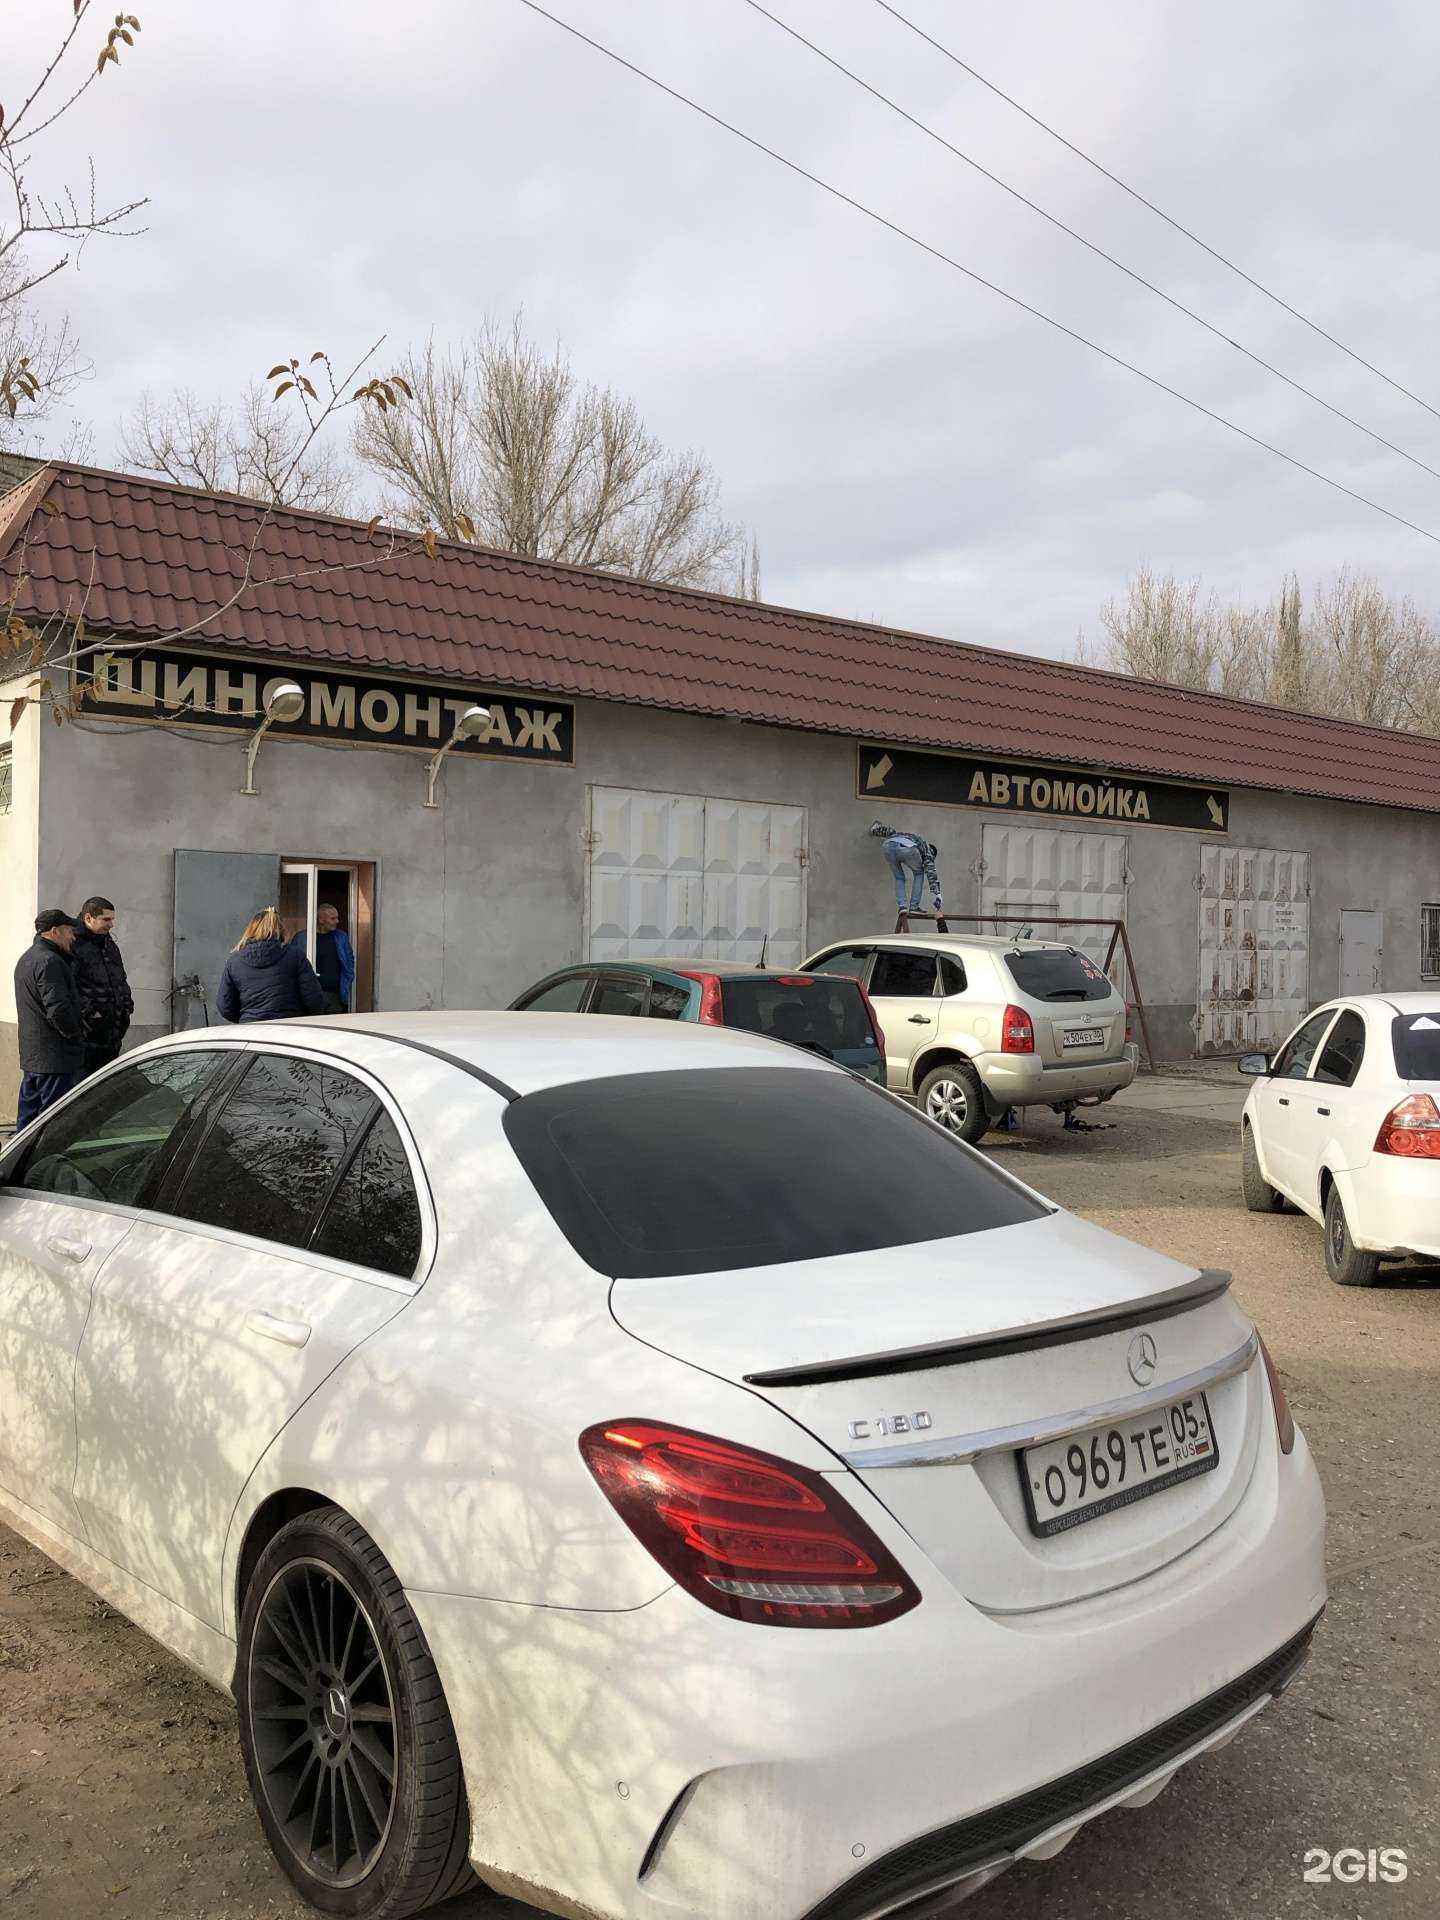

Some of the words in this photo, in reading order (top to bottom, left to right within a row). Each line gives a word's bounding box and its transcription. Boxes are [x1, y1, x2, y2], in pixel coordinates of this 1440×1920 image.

[967, 770, 1150, 820] АВТОМОЙКА
[1170, 1400, 1199, 1443] 05
[1174, 1442, 1196, 1462] RUS
